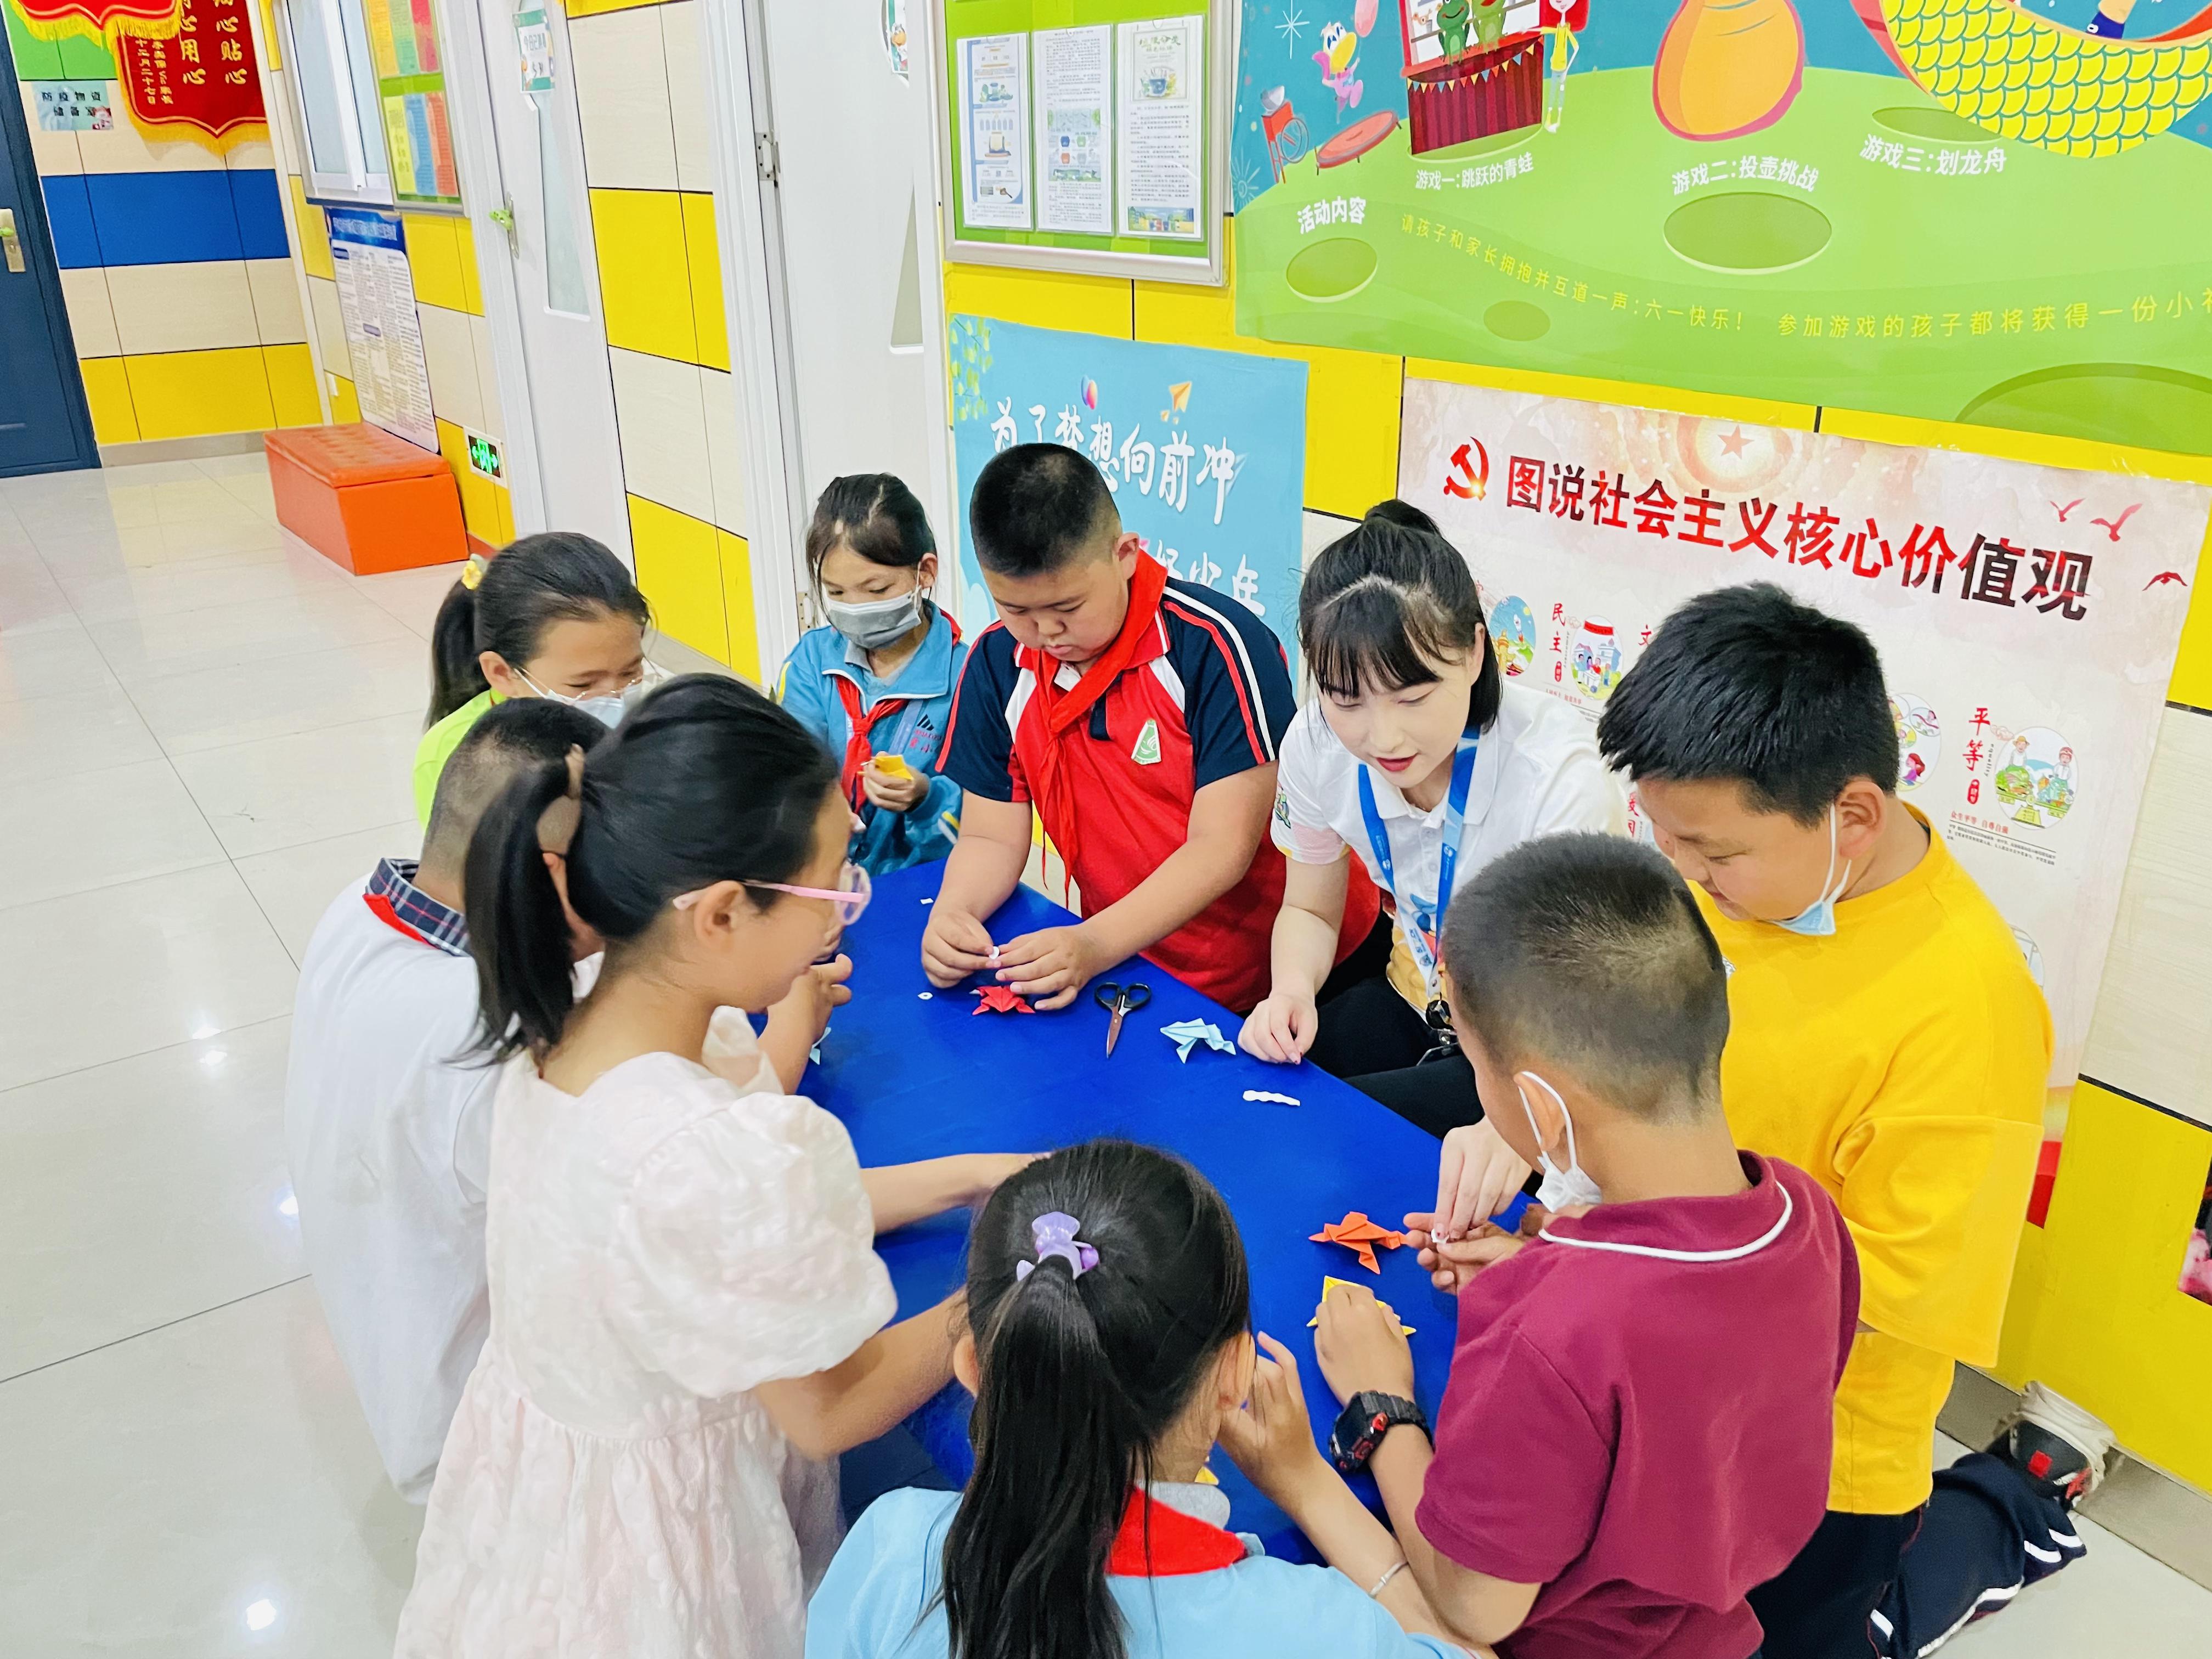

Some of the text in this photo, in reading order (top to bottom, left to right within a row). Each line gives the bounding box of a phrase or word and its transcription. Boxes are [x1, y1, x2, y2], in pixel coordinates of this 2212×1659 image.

[180, 0, 206, 85] 心用心
[213, 0, 247, 85] 心贴心
[1297, 196, 1366, 234] 活动内容
[1506, 455, 2094, 621] 图说社会主义核心价值观
[1549, 603, 1566, 653] 民主
[1962, 708, 1990, 771] 平等
